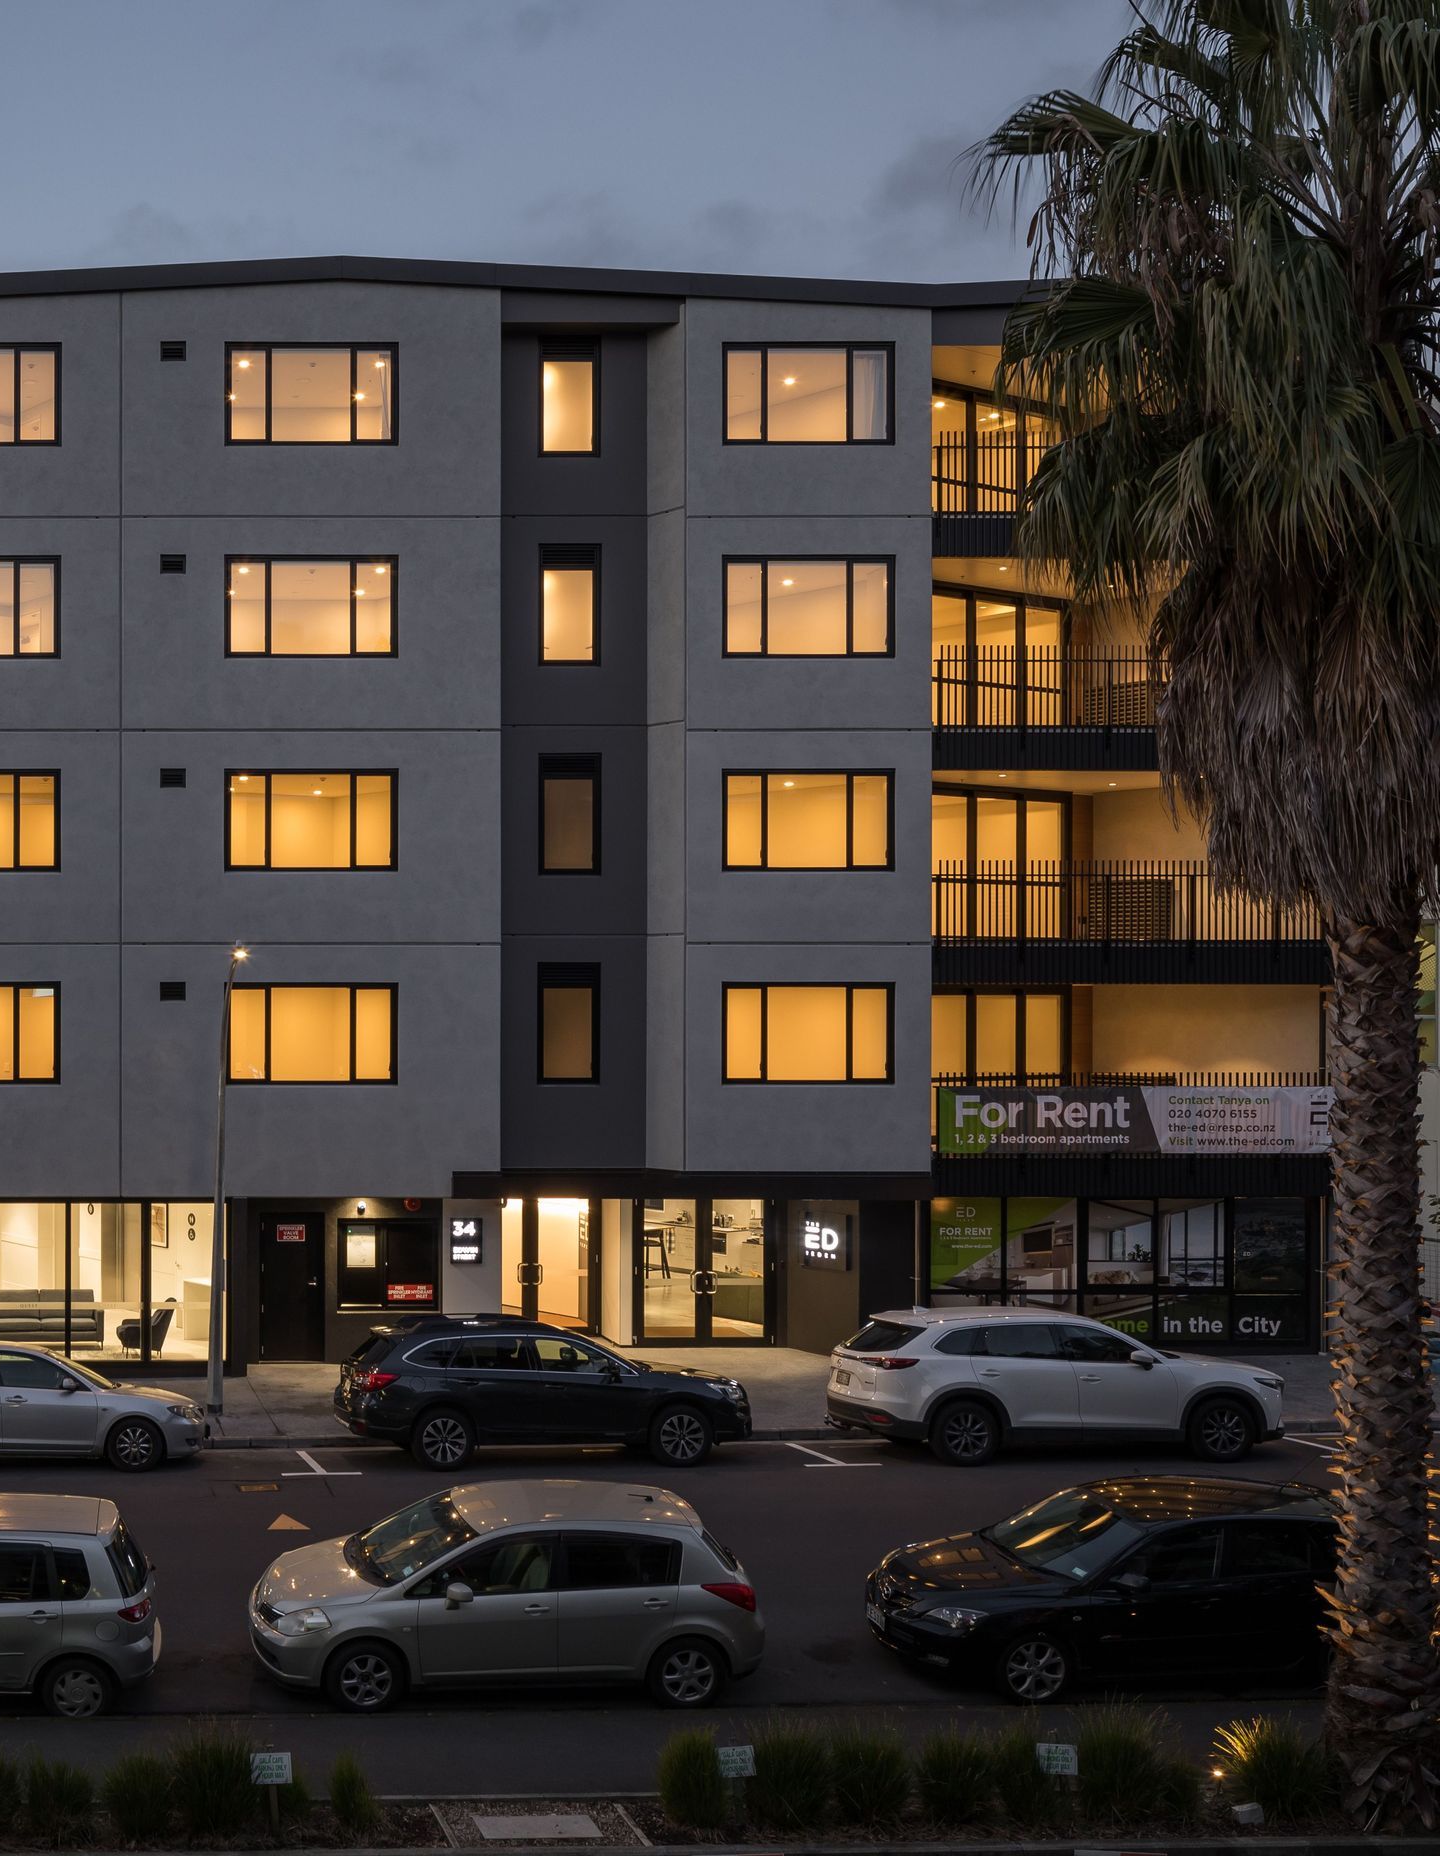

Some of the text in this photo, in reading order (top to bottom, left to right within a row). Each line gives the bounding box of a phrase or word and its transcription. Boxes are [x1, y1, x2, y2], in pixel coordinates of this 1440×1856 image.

[1168, 1096, 1214, 1105] Contact
[1218, 1096, 1252, 1107] Tanya
[955, 1095, 1130, 1128] For Rent
[1168, 1110, 1257, 1118] 020 4070 6155
[1168, 1123, 1276, 1134] the-ed@resp.co.nz
[955, 1134, 1130, 1146] 1, 2 & 3 bedroom apartments
[1168, 1136, 1295, 1146] Visit www.the-ed.com
[956, 1207, 976, 1217] ED
[453, 1221, 476, 1236] 34
[940, 1227, 992, 1235] FOR RENT
[805, 1226, 838, 1250] ED
[1101, 1316, 1281, 1336] ome in the City
